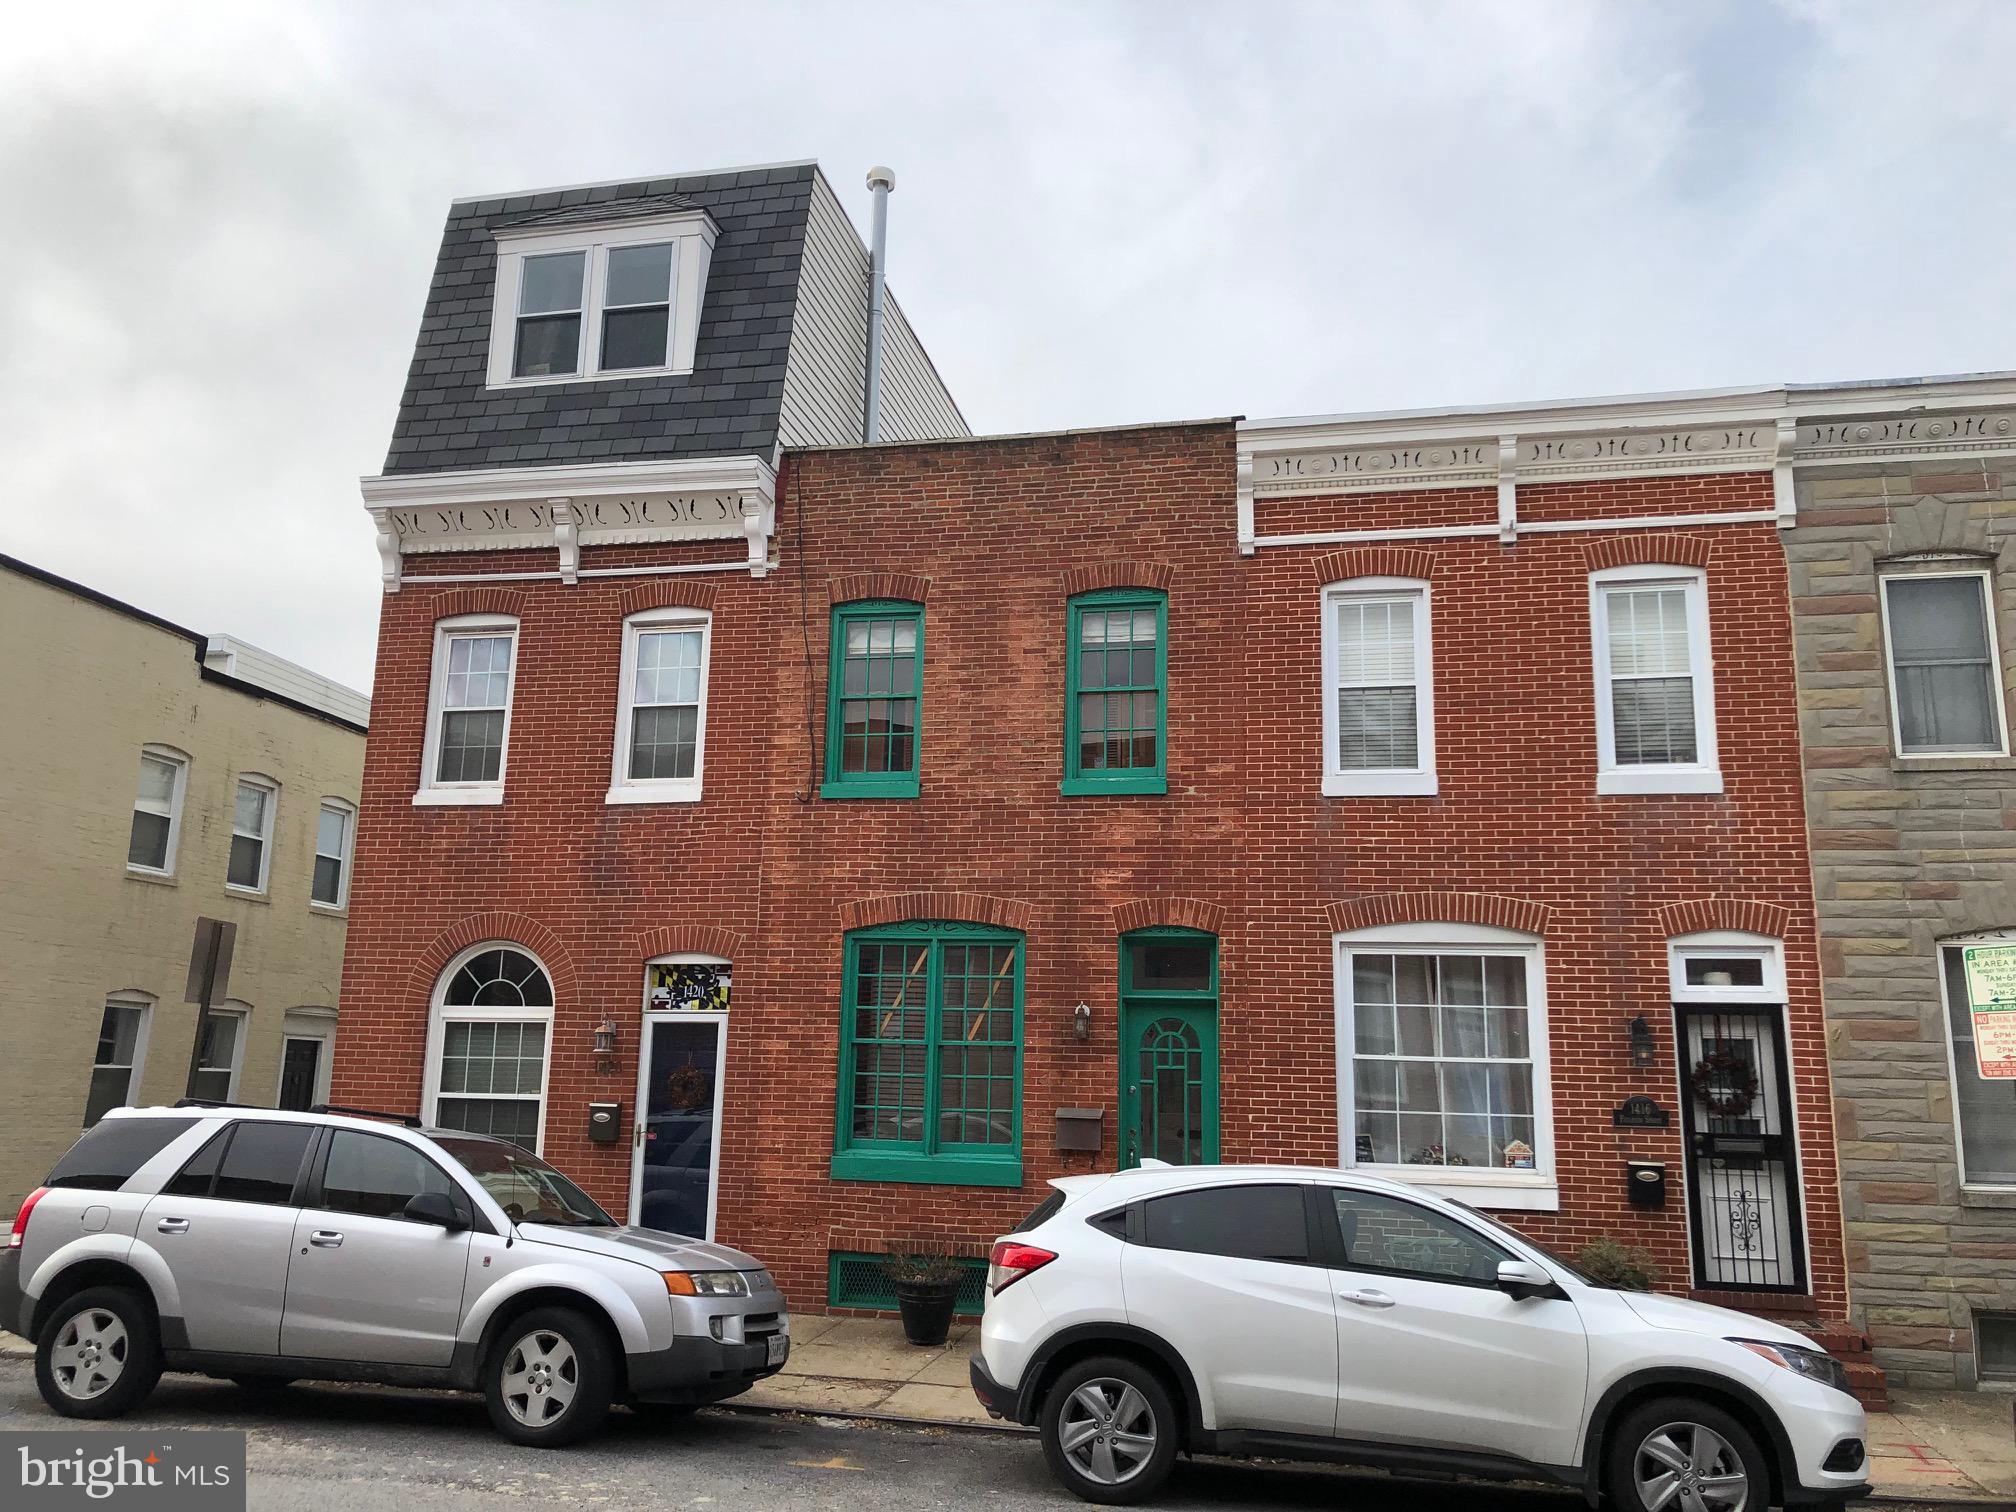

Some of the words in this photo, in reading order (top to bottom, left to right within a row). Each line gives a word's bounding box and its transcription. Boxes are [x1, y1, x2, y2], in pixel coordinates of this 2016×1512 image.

[1968, 951, 1973, 960] 2
[1984, 960, 2009, 968] AREA
[683, 985, 704, 998] 1420
[1977, 1014, 1987, 1024] NO
